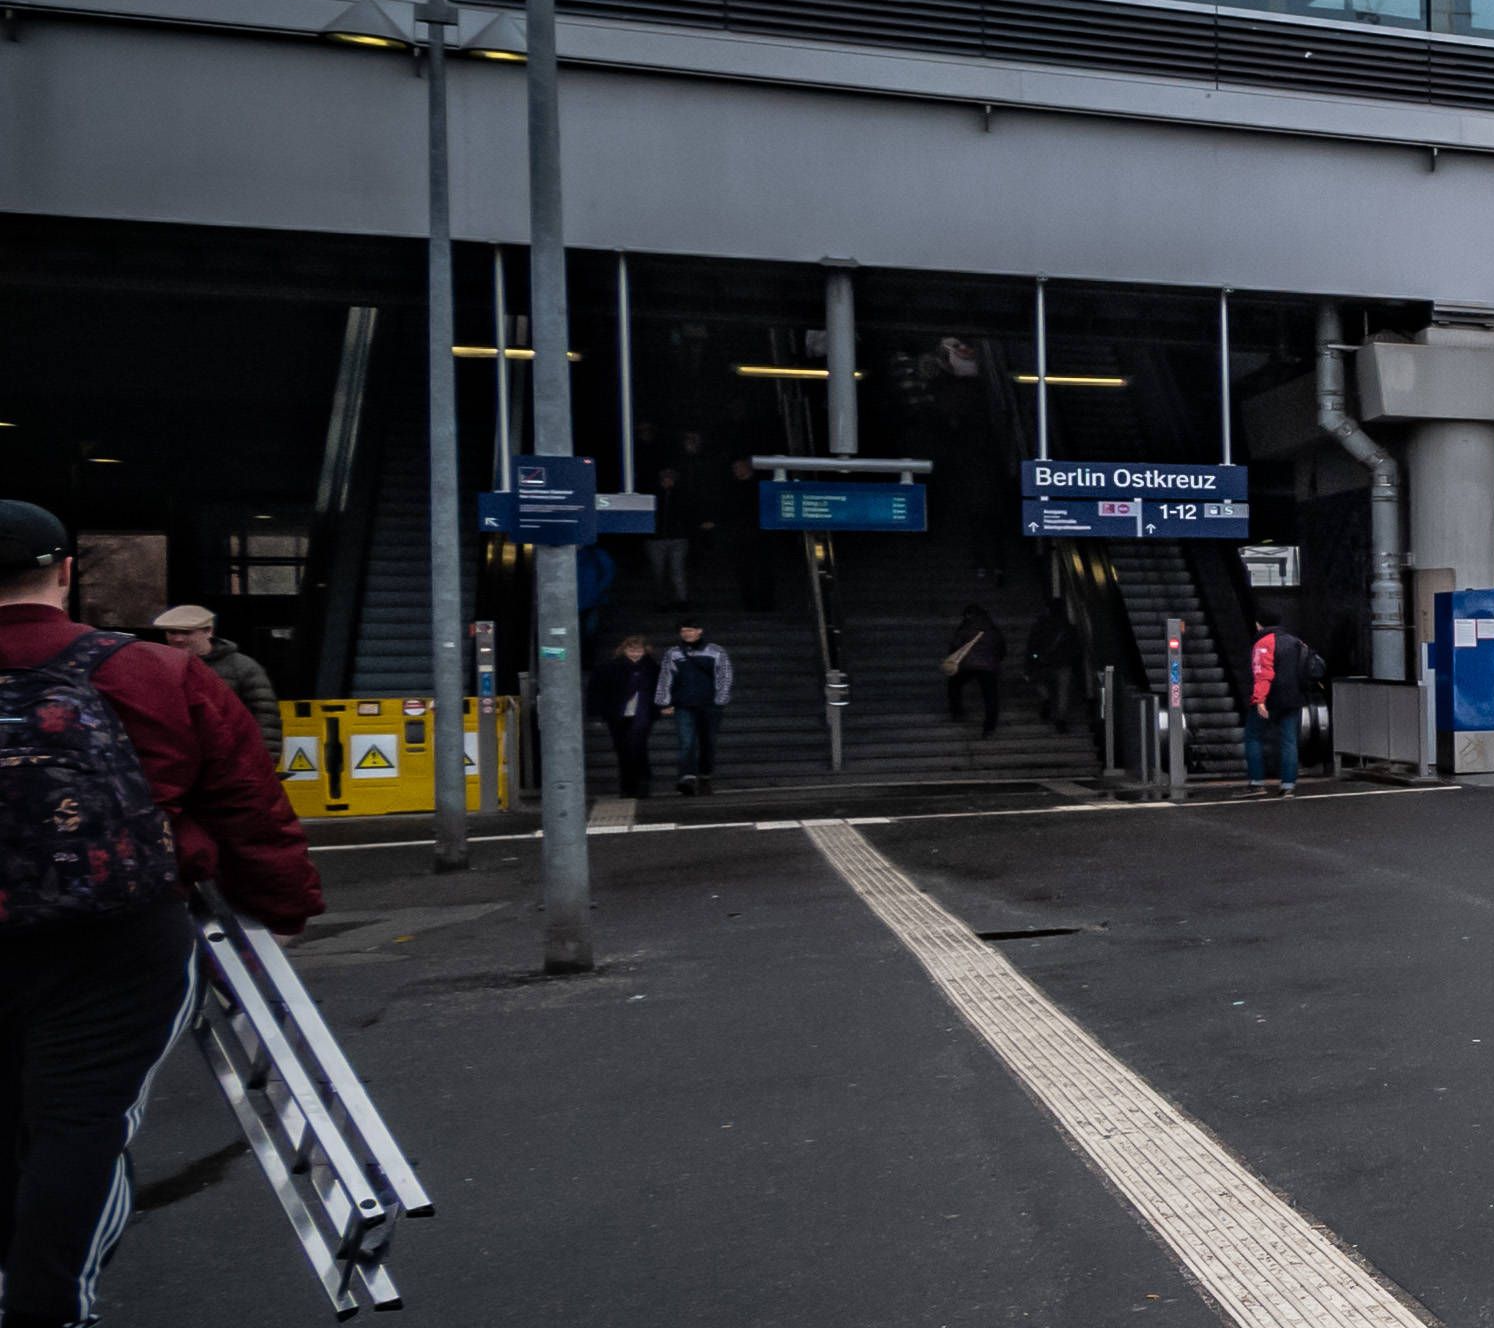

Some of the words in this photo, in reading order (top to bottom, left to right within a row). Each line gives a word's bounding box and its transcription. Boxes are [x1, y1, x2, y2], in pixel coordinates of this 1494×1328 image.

[1035, 467, 1105, 487] Berlin
[1113, 469, 1216, 489] Ostkreuz
[1159, 505, 1197, 520] 1-12
